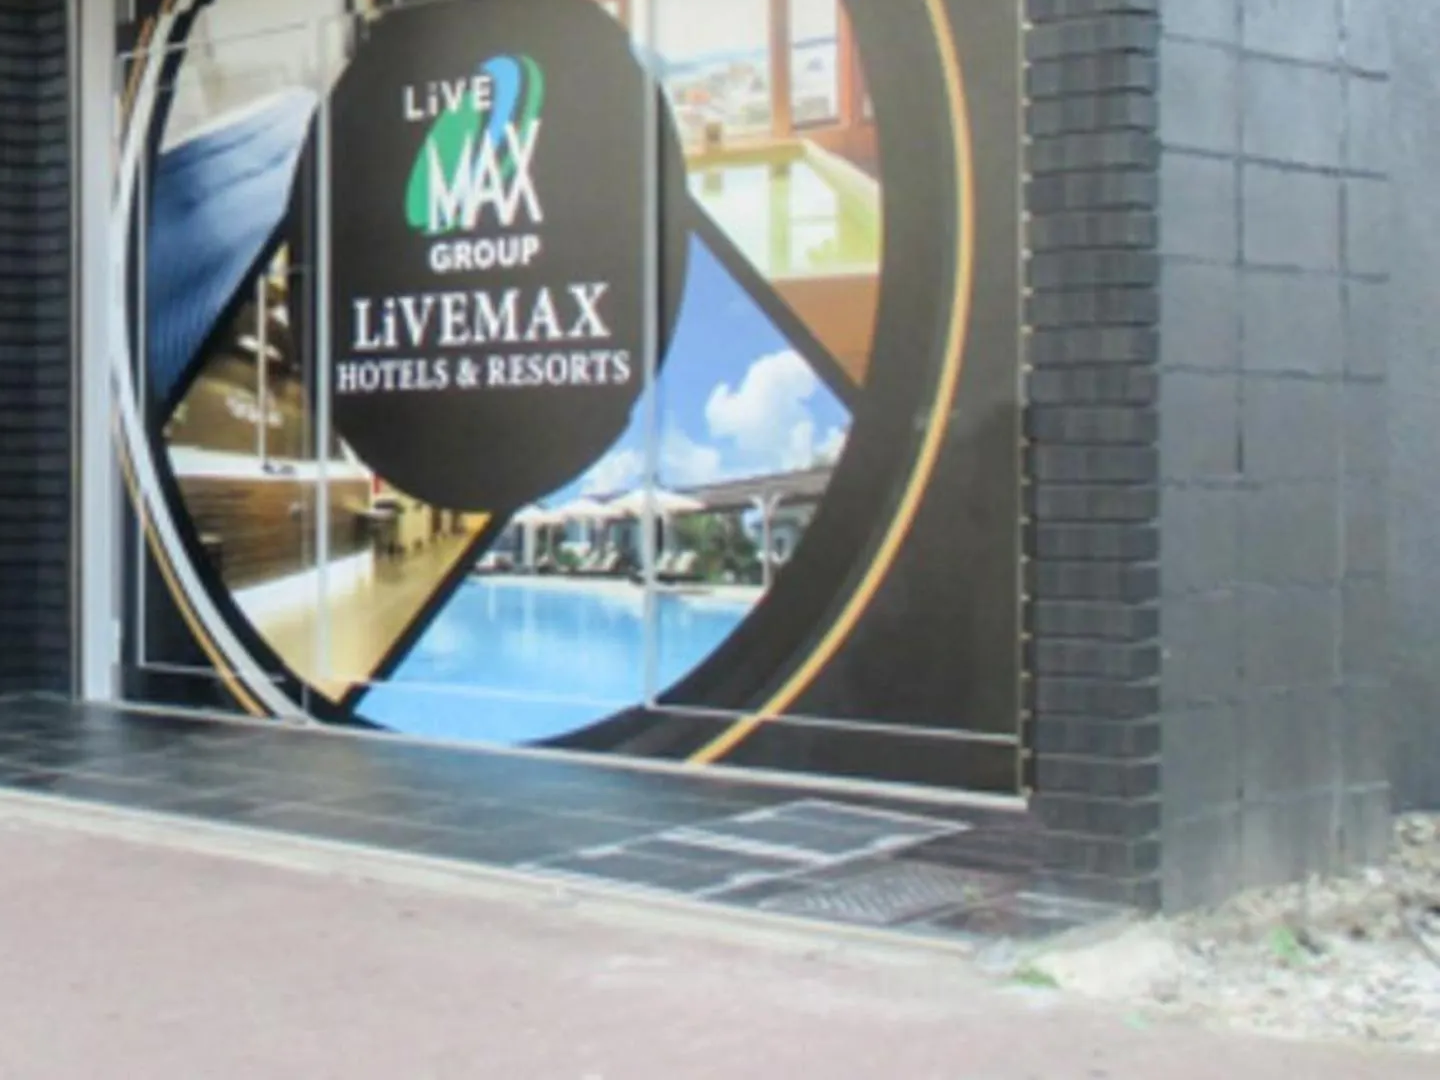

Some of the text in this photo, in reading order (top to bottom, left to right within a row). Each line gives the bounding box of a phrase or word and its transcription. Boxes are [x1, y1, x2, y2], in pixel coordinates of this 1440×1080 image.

[427, 119, 543, 232] MAX
[430, 234, 541, 273] GROUP
[337, 350, 631, 392] HOTELS & RESORTS
